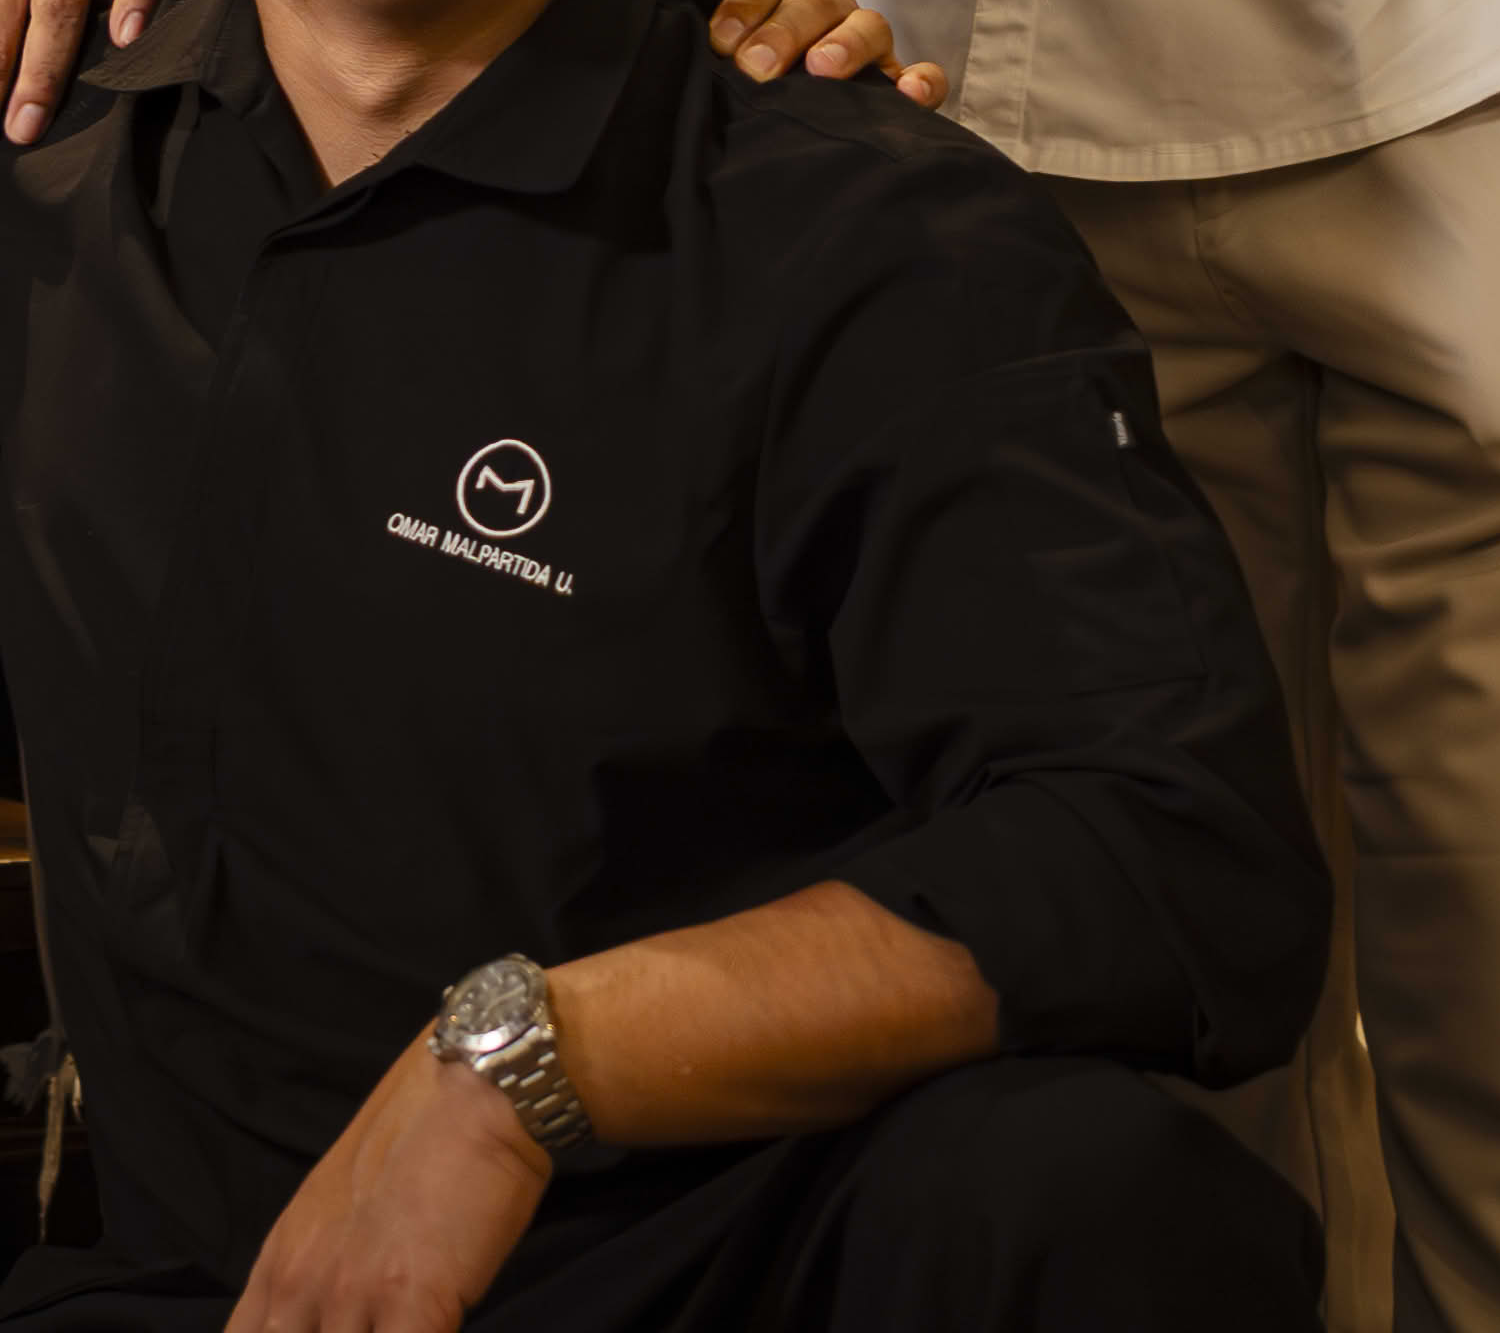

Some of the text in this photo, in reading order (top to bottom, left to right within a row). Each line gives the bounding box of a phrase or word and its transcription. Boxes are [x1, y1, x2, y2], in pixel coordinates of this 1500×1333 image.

[387, 512, 573, 595] OMAR MALPARTIDA U.
